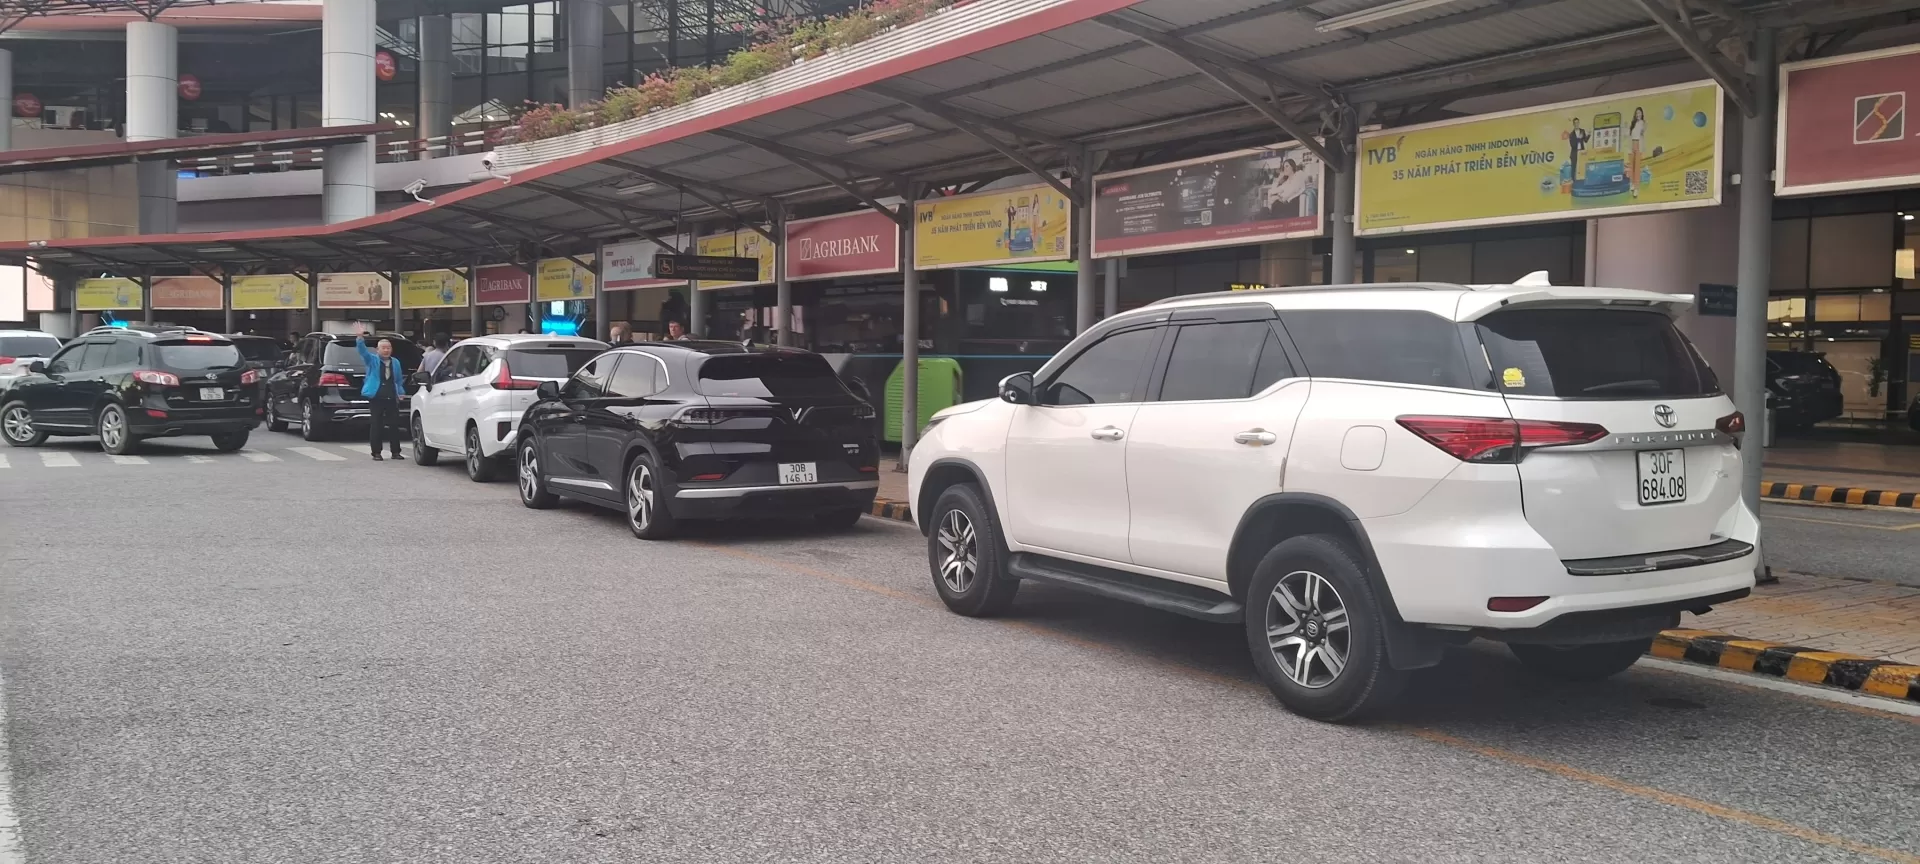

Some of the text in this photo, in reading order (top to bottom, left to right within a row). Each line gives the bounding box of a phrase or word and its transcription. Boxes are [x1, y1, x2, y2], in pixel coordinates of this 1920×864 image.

[1368, 146, 1397, 165] IVB
[1415, 136, 1530, 159] NGÂN HÀNG TNHH INDOVINA
[1392, 149, 1555, 181] 35 NĂM PHÁT TRIỂN BỀN VỮNG
[920, 211, 933, 223] IVB
[812, 235, 880, 259] AGRIBANK
[487, 279, 523, 291] AGRIBANK
[790, 463, 806, 473] 30B
[1650, 452, 1673, 475] 30F
[785, 473, 813, 483] 146.13
[1642, 476, 1684, 501] 684.08
